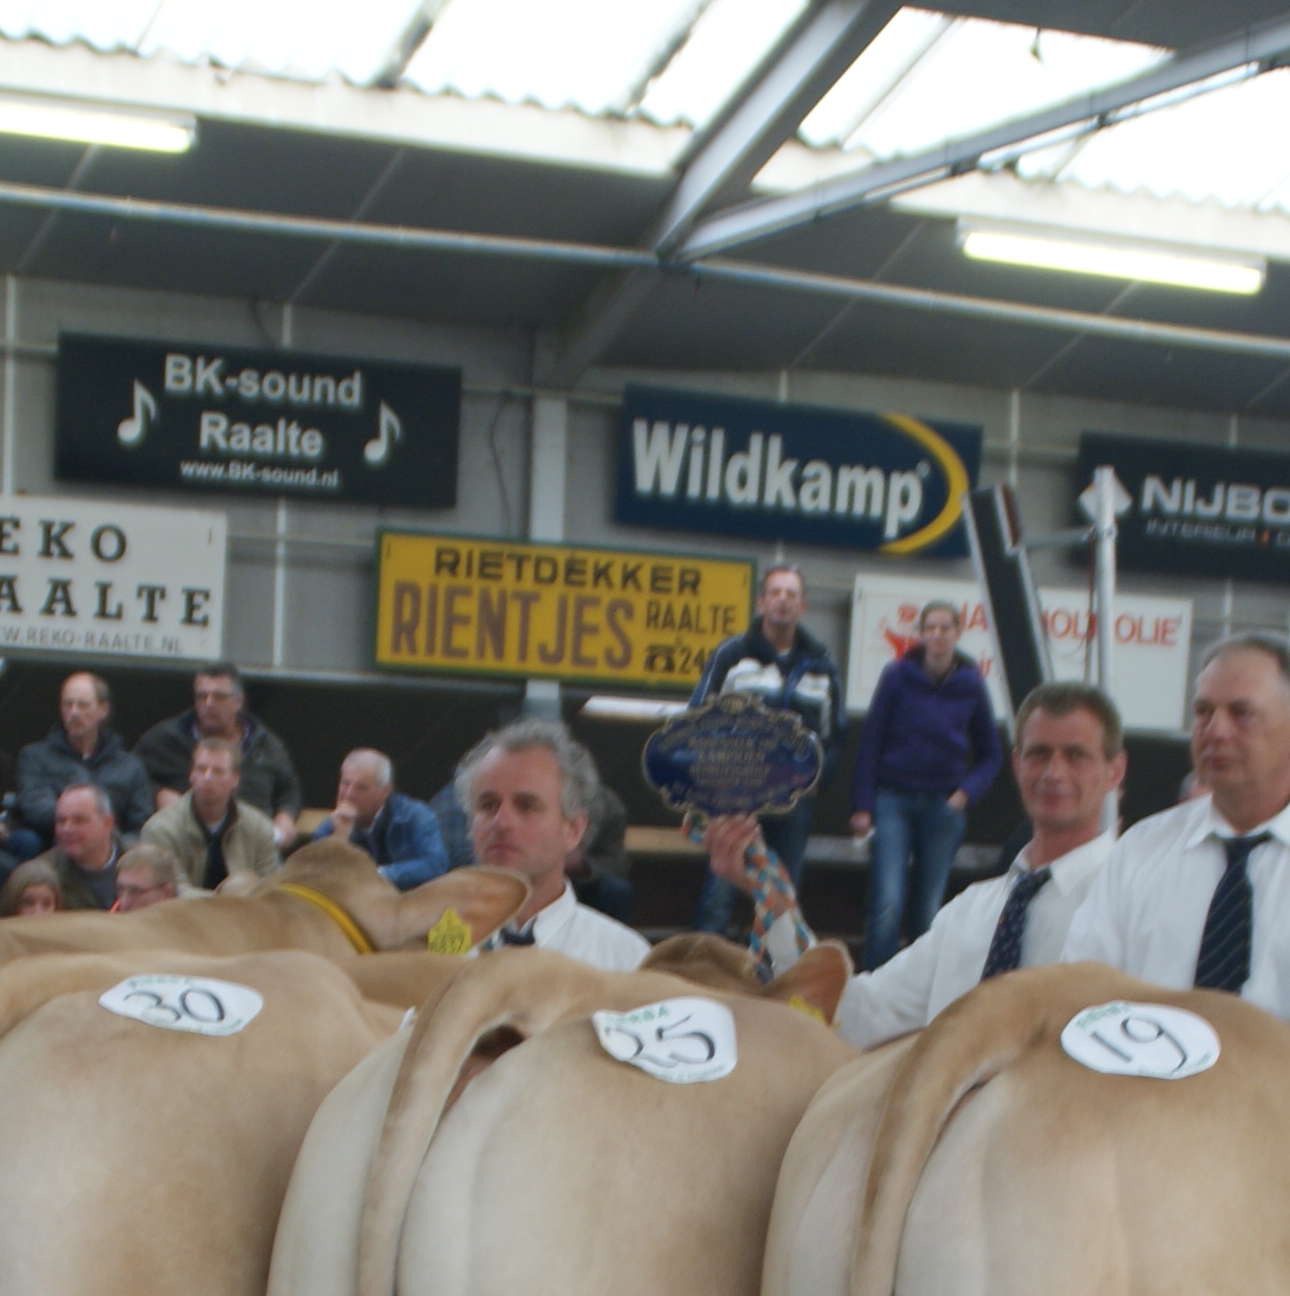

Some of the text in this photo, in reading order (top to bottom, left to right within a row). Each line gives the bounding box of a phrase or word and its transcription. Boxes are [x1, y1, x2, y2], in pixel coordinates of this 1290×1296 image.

[164, 352, 364, 409] BK-sound
[199, 411, 324, 458] Raalte
[180, 457, 341, 488] www.BK-sound.nl
[633, 416, 923, 539] Wildkamp
[434, 545, 703, 595] RIETDEKKER
[390, 579, 738, 671] RIENTJES RAALTE
[1114, 613, 1179, 646] OLIE
[123, 986, 226, 1024] 30
[1090, 1014, 1188, 1076] 19
